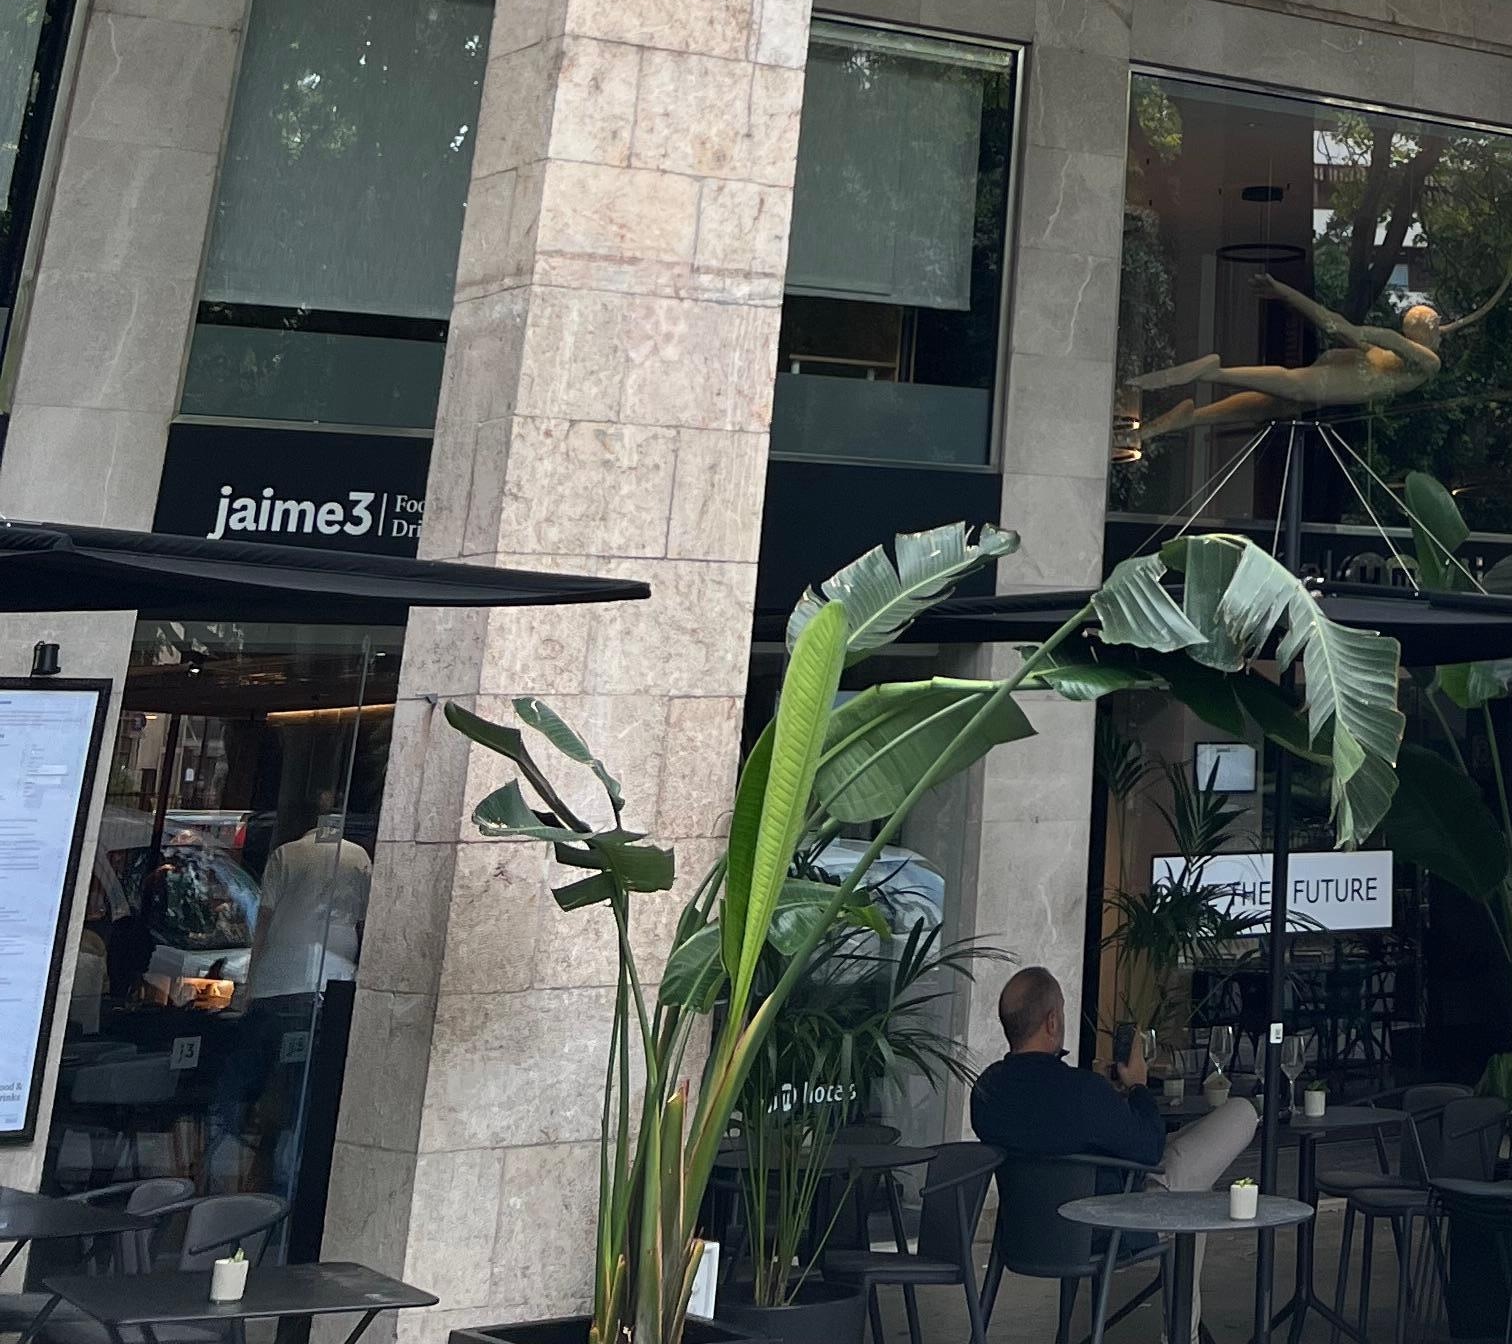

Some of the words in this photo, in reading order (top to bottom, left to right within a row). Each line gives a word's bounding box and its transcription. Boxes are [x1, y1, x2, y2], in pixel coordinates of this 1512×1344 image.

[206, 485, 375, 540] jaime3
[395, 494, 426, 513] Foo
[391, 519, 422, 538] Dri
[1293, 876, 1378, 904] FUTURE
